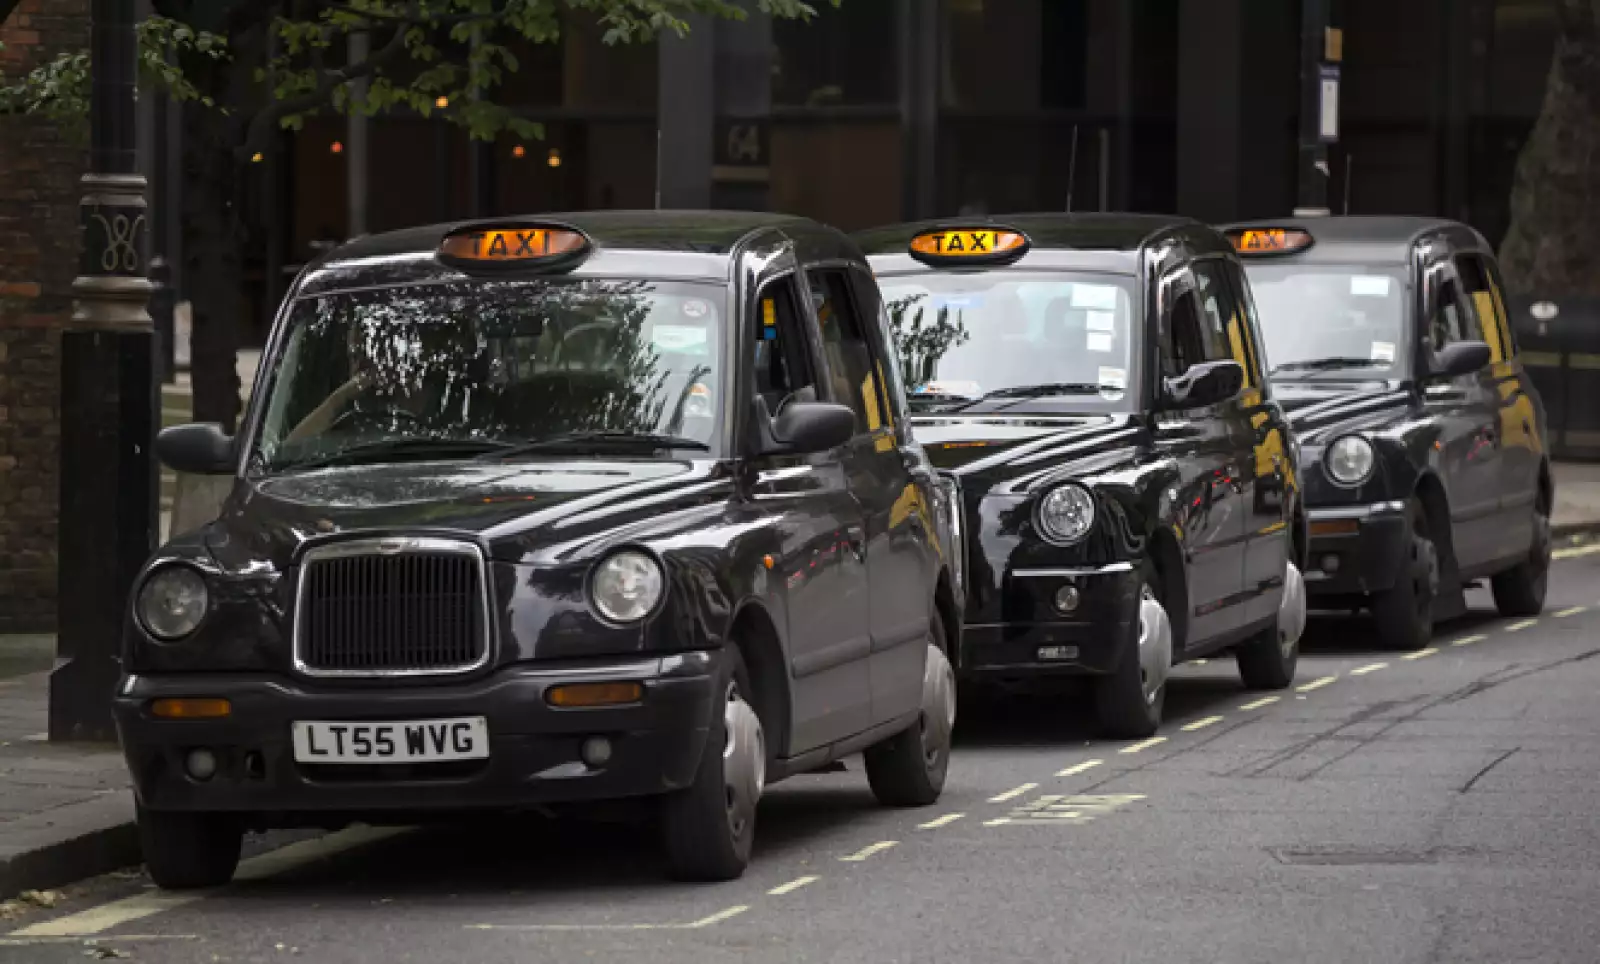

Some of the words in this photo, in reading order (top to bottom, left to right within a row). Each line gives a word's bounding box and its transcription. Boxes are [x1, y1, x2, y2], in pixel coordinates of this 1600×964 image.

[727, 124, 760, 162] 64
[469, 231, 550, 256] TAXI
[932, 232, 999, 252] TAXI
[306, 725, 396, 757] LT55
[404, 722, 474, 756] WVG
